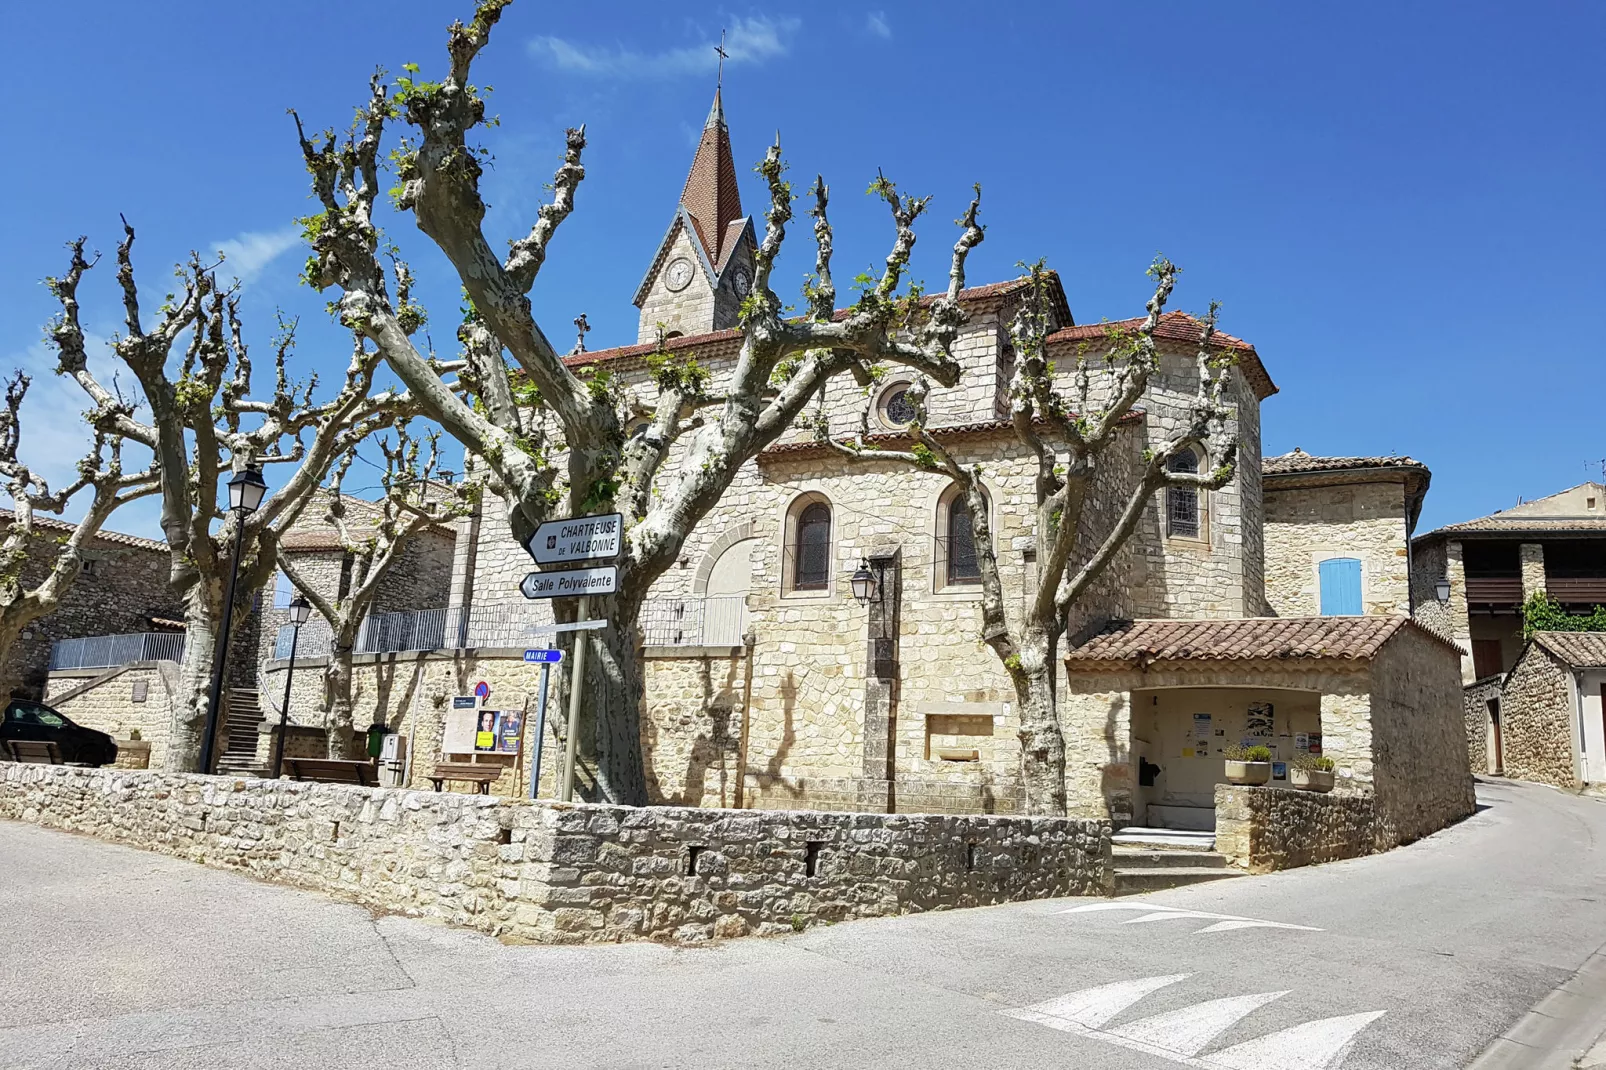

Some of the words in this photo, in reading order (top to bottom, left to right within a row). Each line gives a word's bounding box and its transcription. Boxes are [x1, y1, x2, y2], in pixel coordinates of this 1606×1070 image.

[561, 520, 617, 538] CHARTREUSE
[558, 547, 566, 556] DE
[570, 538, 616, 554] VALBONNE
[532, 578, 554, 592] Salle
[558, 575, 612, 591] Polyvalente
[525, 651, 548, 661] MAIRIE
